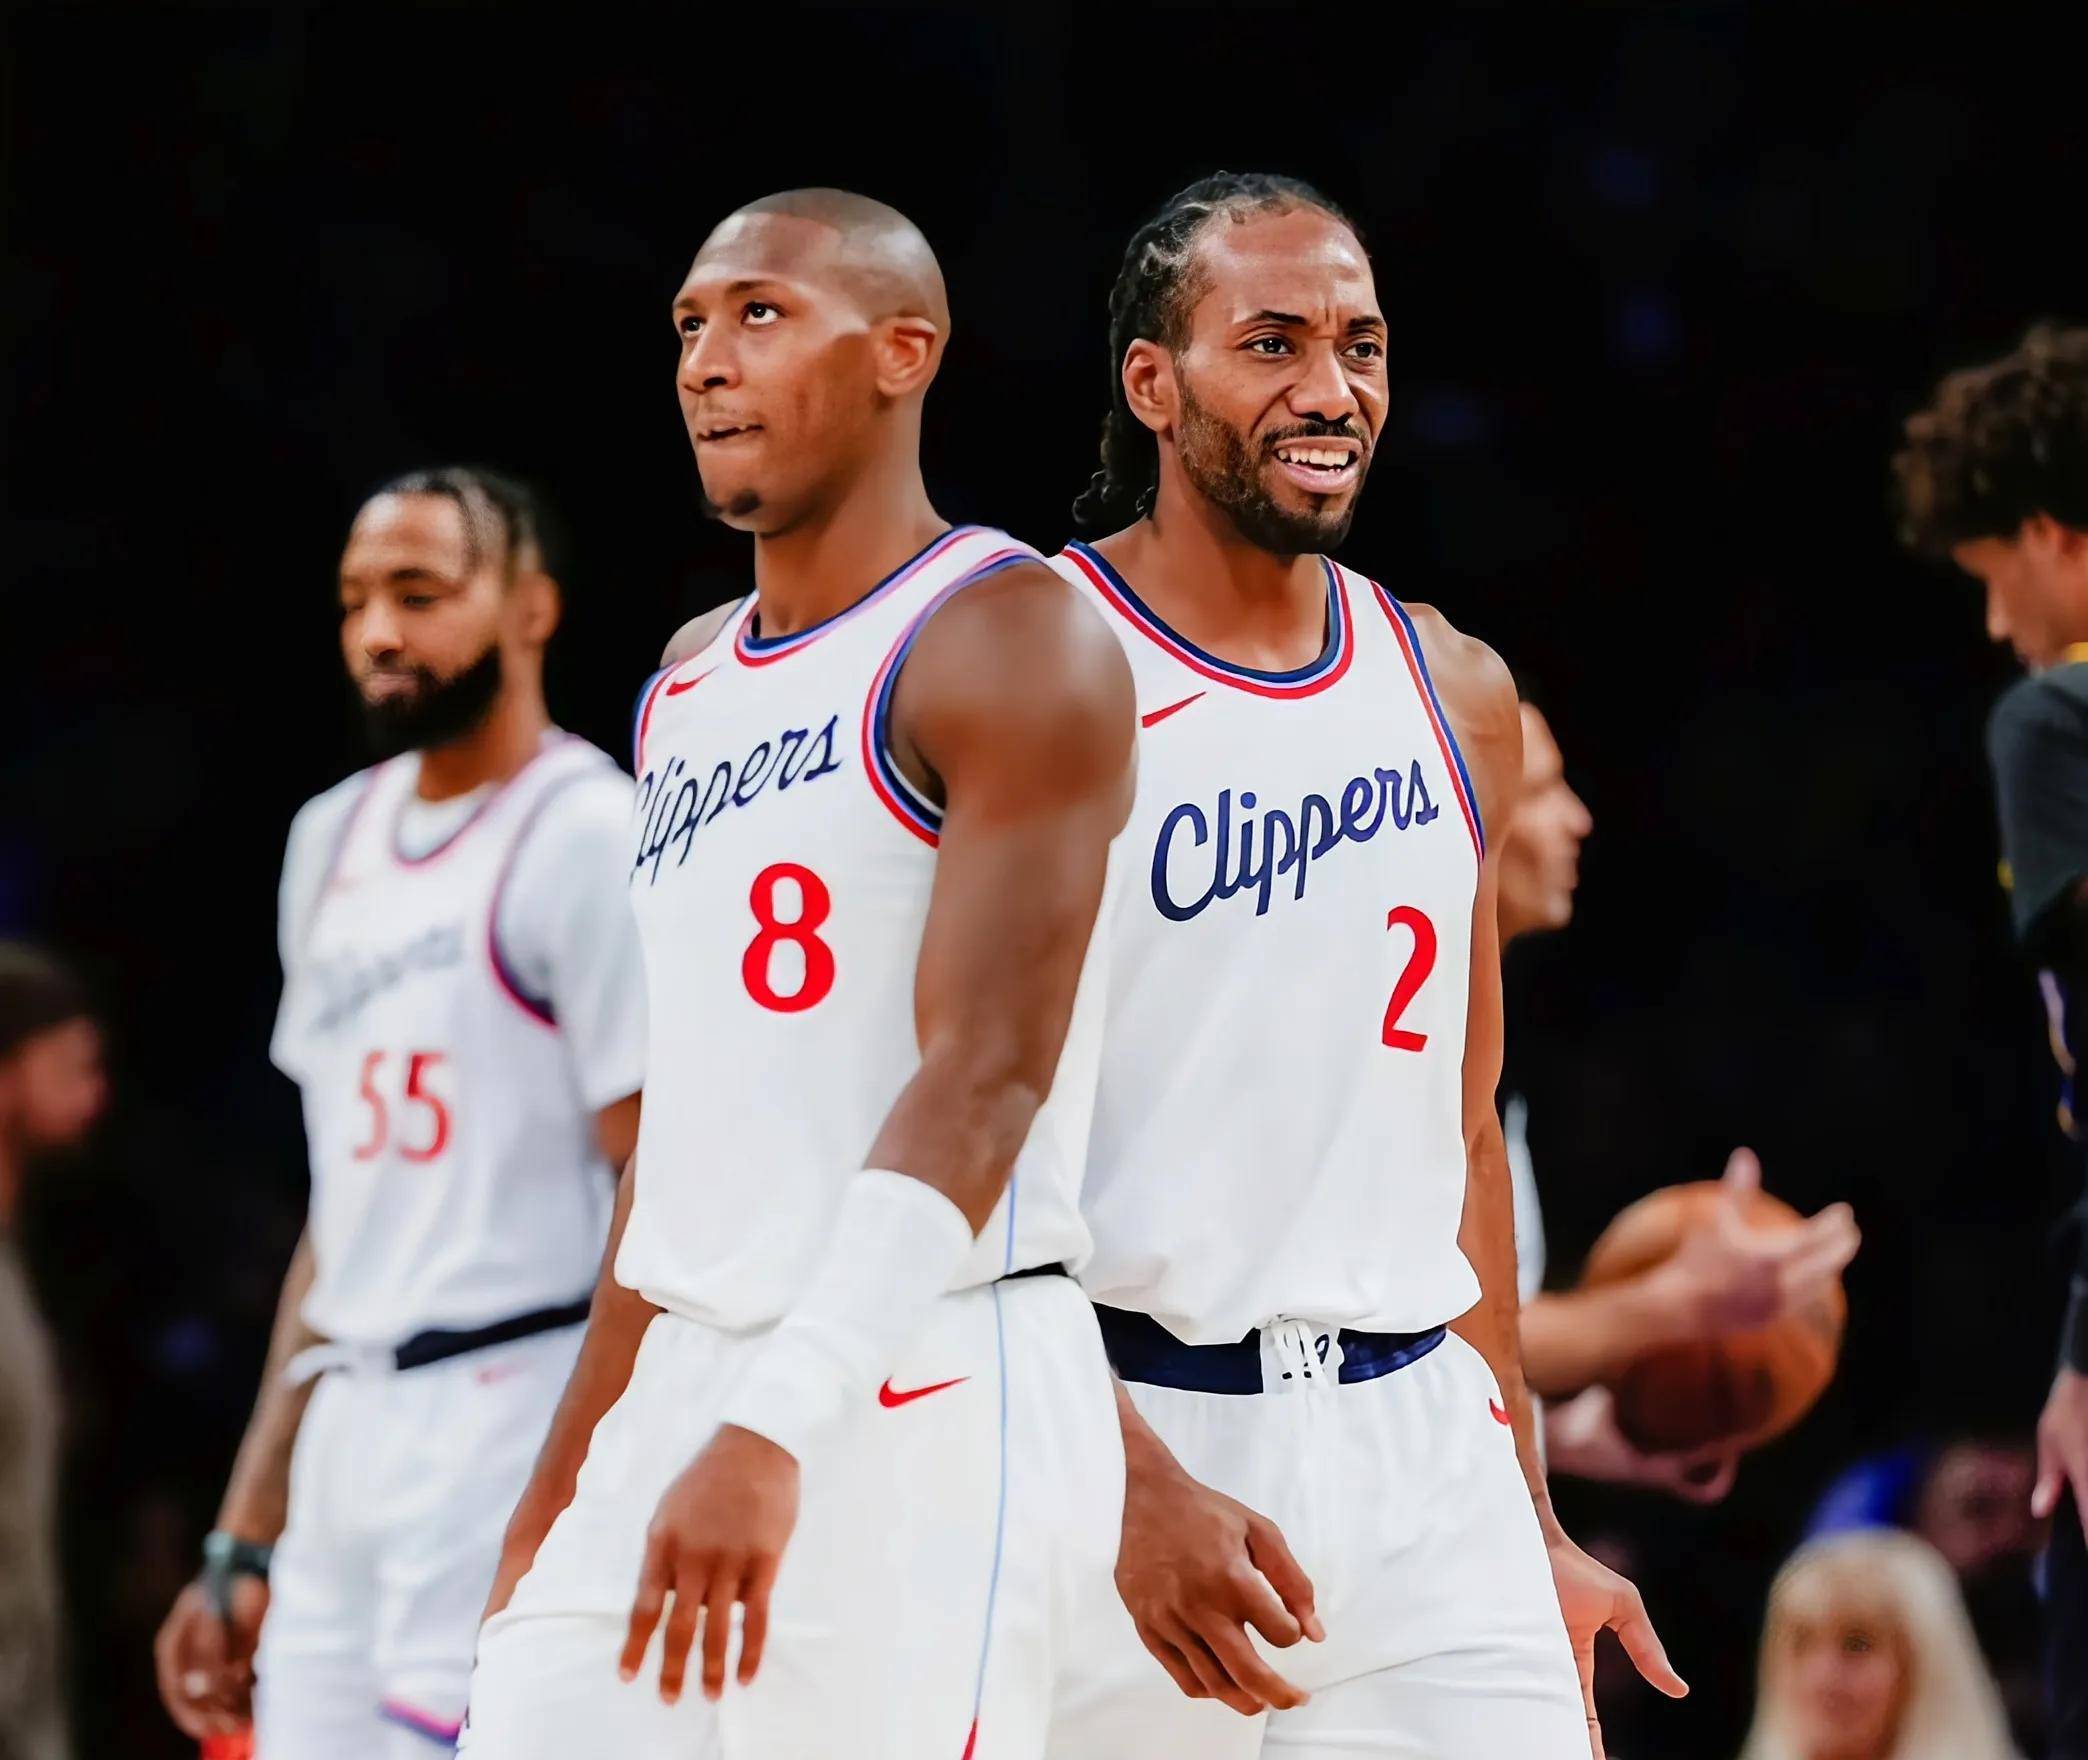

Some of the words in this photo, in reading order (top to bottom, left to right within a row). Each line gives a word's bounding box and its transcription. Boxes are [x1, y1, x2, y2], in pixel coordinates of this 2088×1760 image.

[1151, 759, 1439, 922] Clippers
[742, 862, 835, 1013] 8
[1382, 905, 1437, 1052] 2
[352, 1049, 453, 1163] 55
